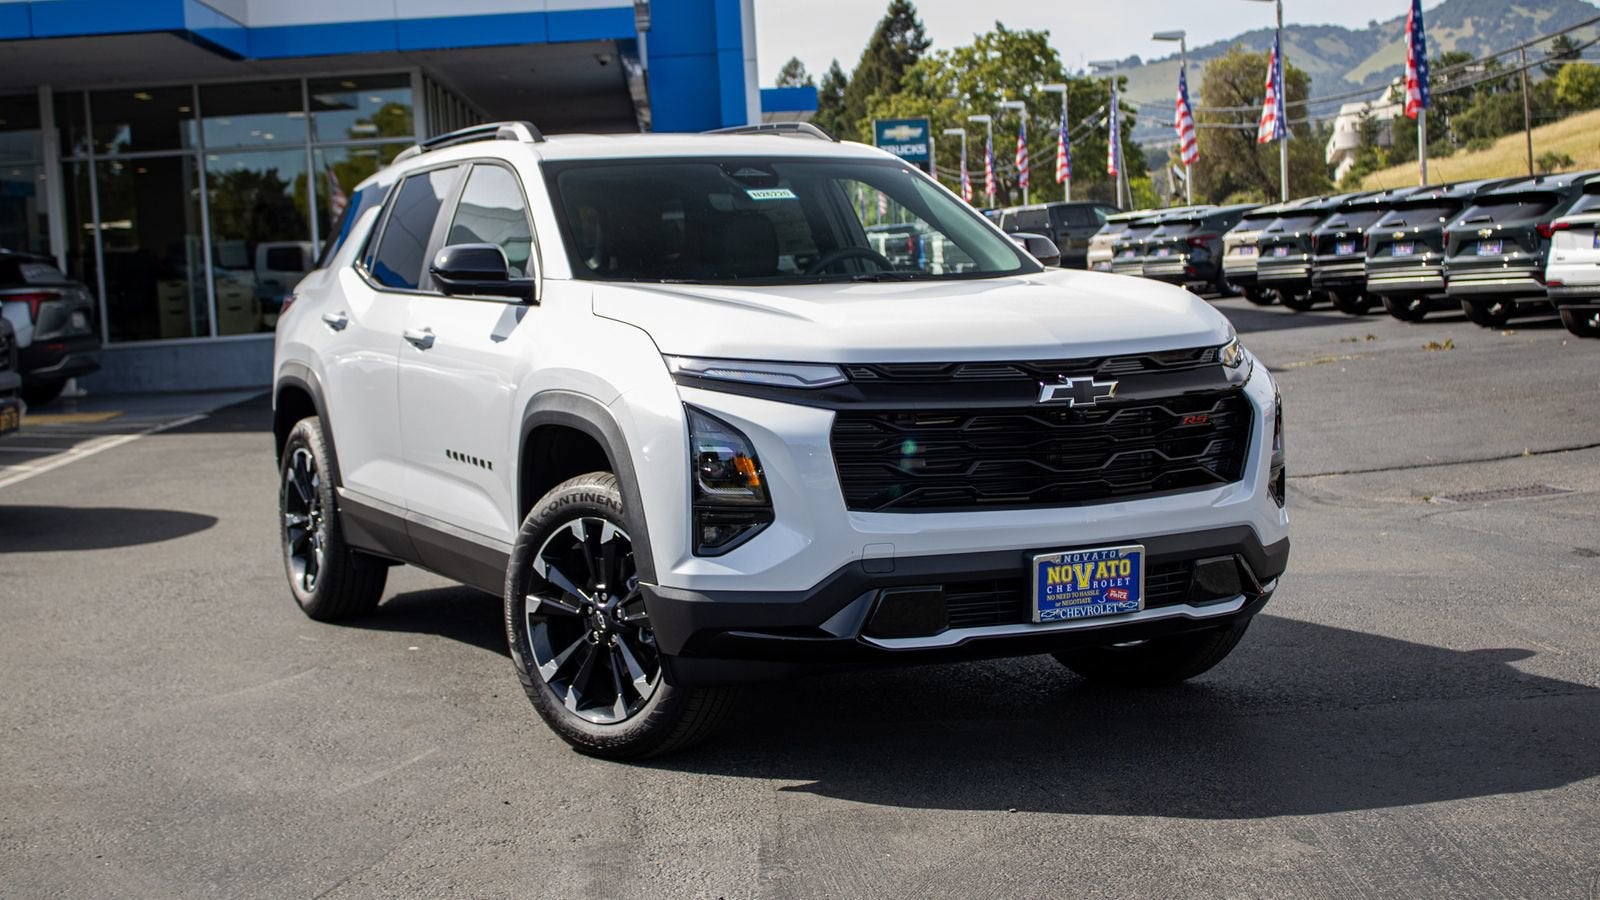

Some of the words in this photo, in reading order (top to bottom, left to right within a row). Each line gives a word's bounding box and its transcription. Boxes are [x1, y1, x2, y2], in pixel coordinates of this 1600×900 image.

[880, 143, 927, 156] TRUCKS
[1183, 415, 1209, 425] RS
[445, 449, 493, 471] EQUINOX
[1064, 551, 1116, 563] NOVATO
[1047, 559, 1131, 590] NOVATO
[1056, 592, 1071, 600] NEED
[1079, 589, 1100, 597] HASSLE
[1062, 597, 1092, 606] NEGOTIATE
[1060, 603, 1118, 618] CHEVROLET
